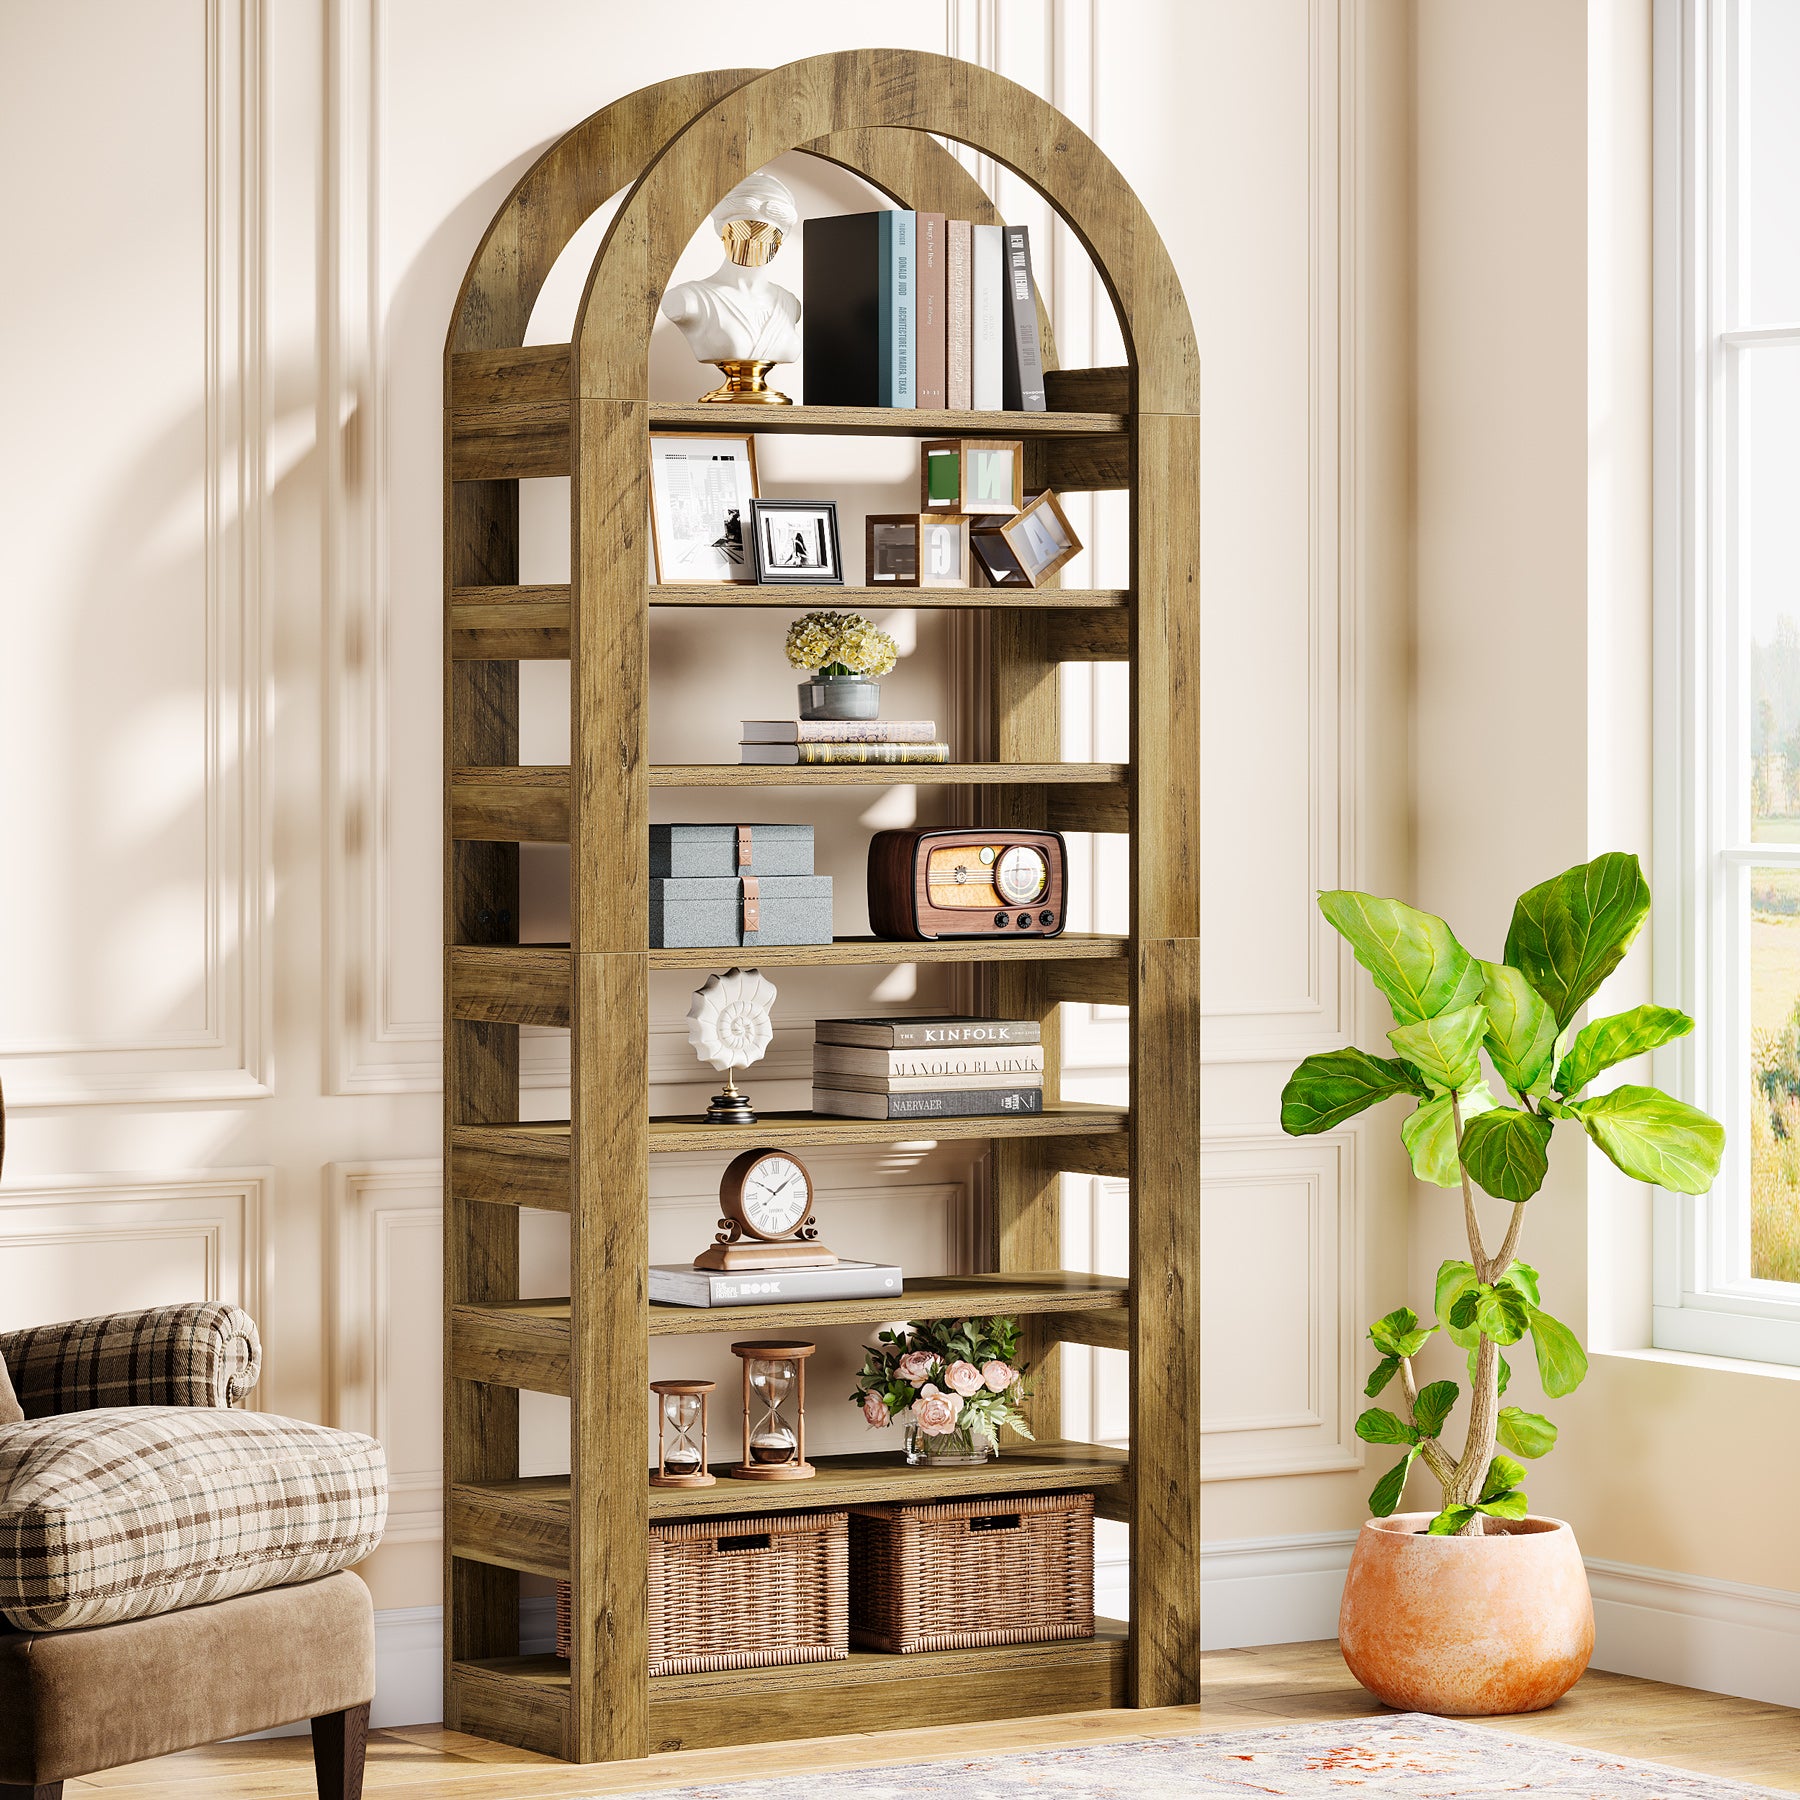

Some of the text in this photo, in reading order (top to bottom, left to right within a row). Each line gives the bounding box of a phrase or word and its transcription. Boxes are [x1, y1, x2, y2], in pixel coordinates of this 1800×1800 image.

[898, 257, 907, 296] DONALD JUDD
[1010, 234, 1029, 300] NEW YORK INTERIORS
[898, 307, 907, 348] ARCHITECTURE
[898, 377, 907, 394] TEXAS
[1022, 513, 1059, 565] A
[925, 1028, 1010, 1042] KINFOLK
[895, 1056, 1039, 1076] MANOLO BLAHNÍK
[892, 1100, 942, 1112] NAERVAER
[740, 1282, 780, 1295] BOOK
